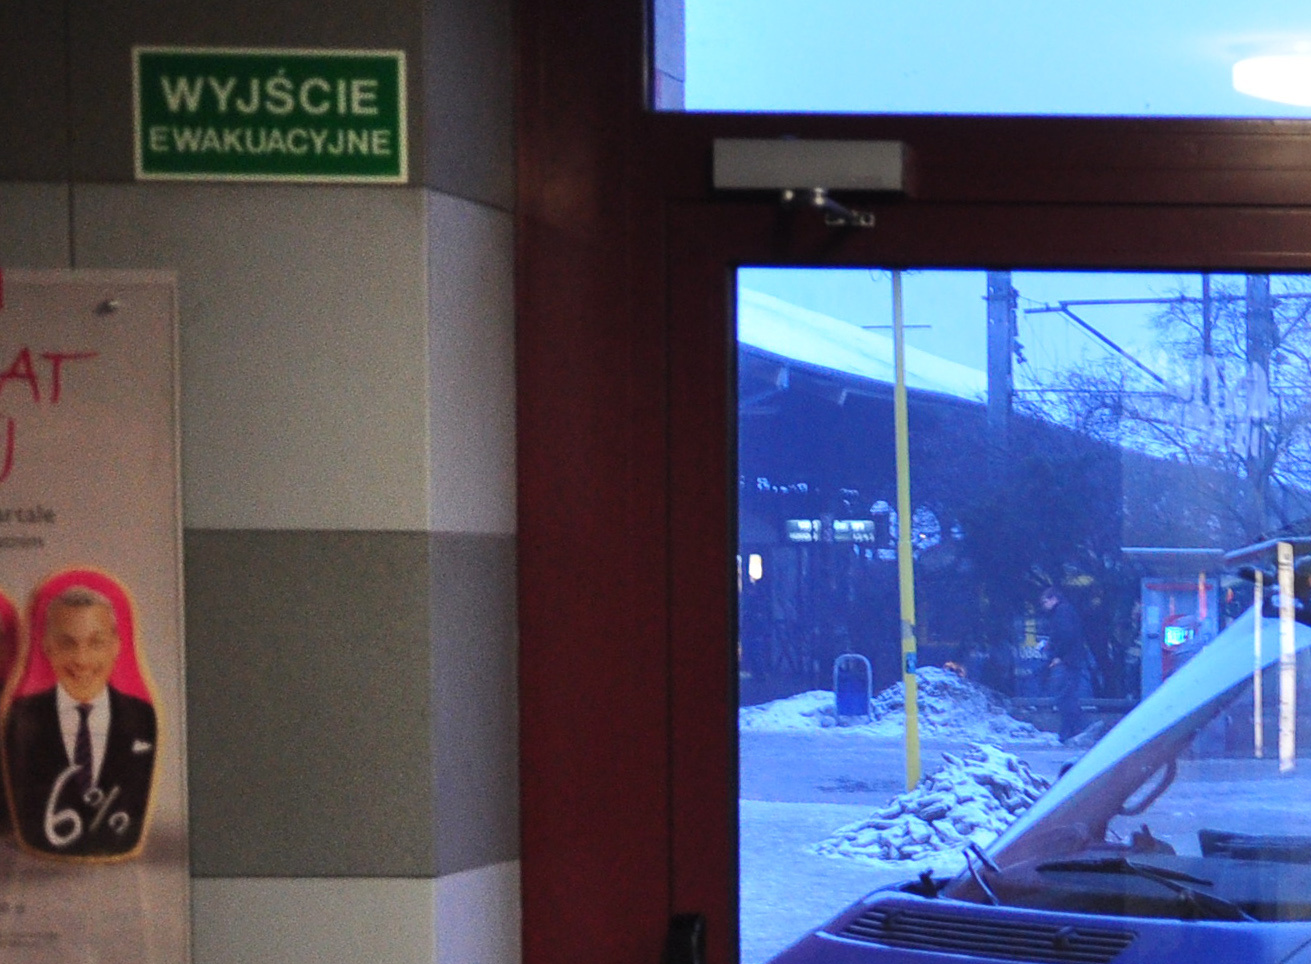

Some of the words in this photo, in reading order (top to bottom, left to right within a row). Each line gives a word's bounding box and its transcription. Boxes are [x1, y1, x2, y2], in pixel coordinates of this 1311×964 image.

[160, 67, 380, 117] WYJŚCIE
[150, 126, 392, 156] EWAKUACYJNE
[44, 764, 130, 847] 6%
